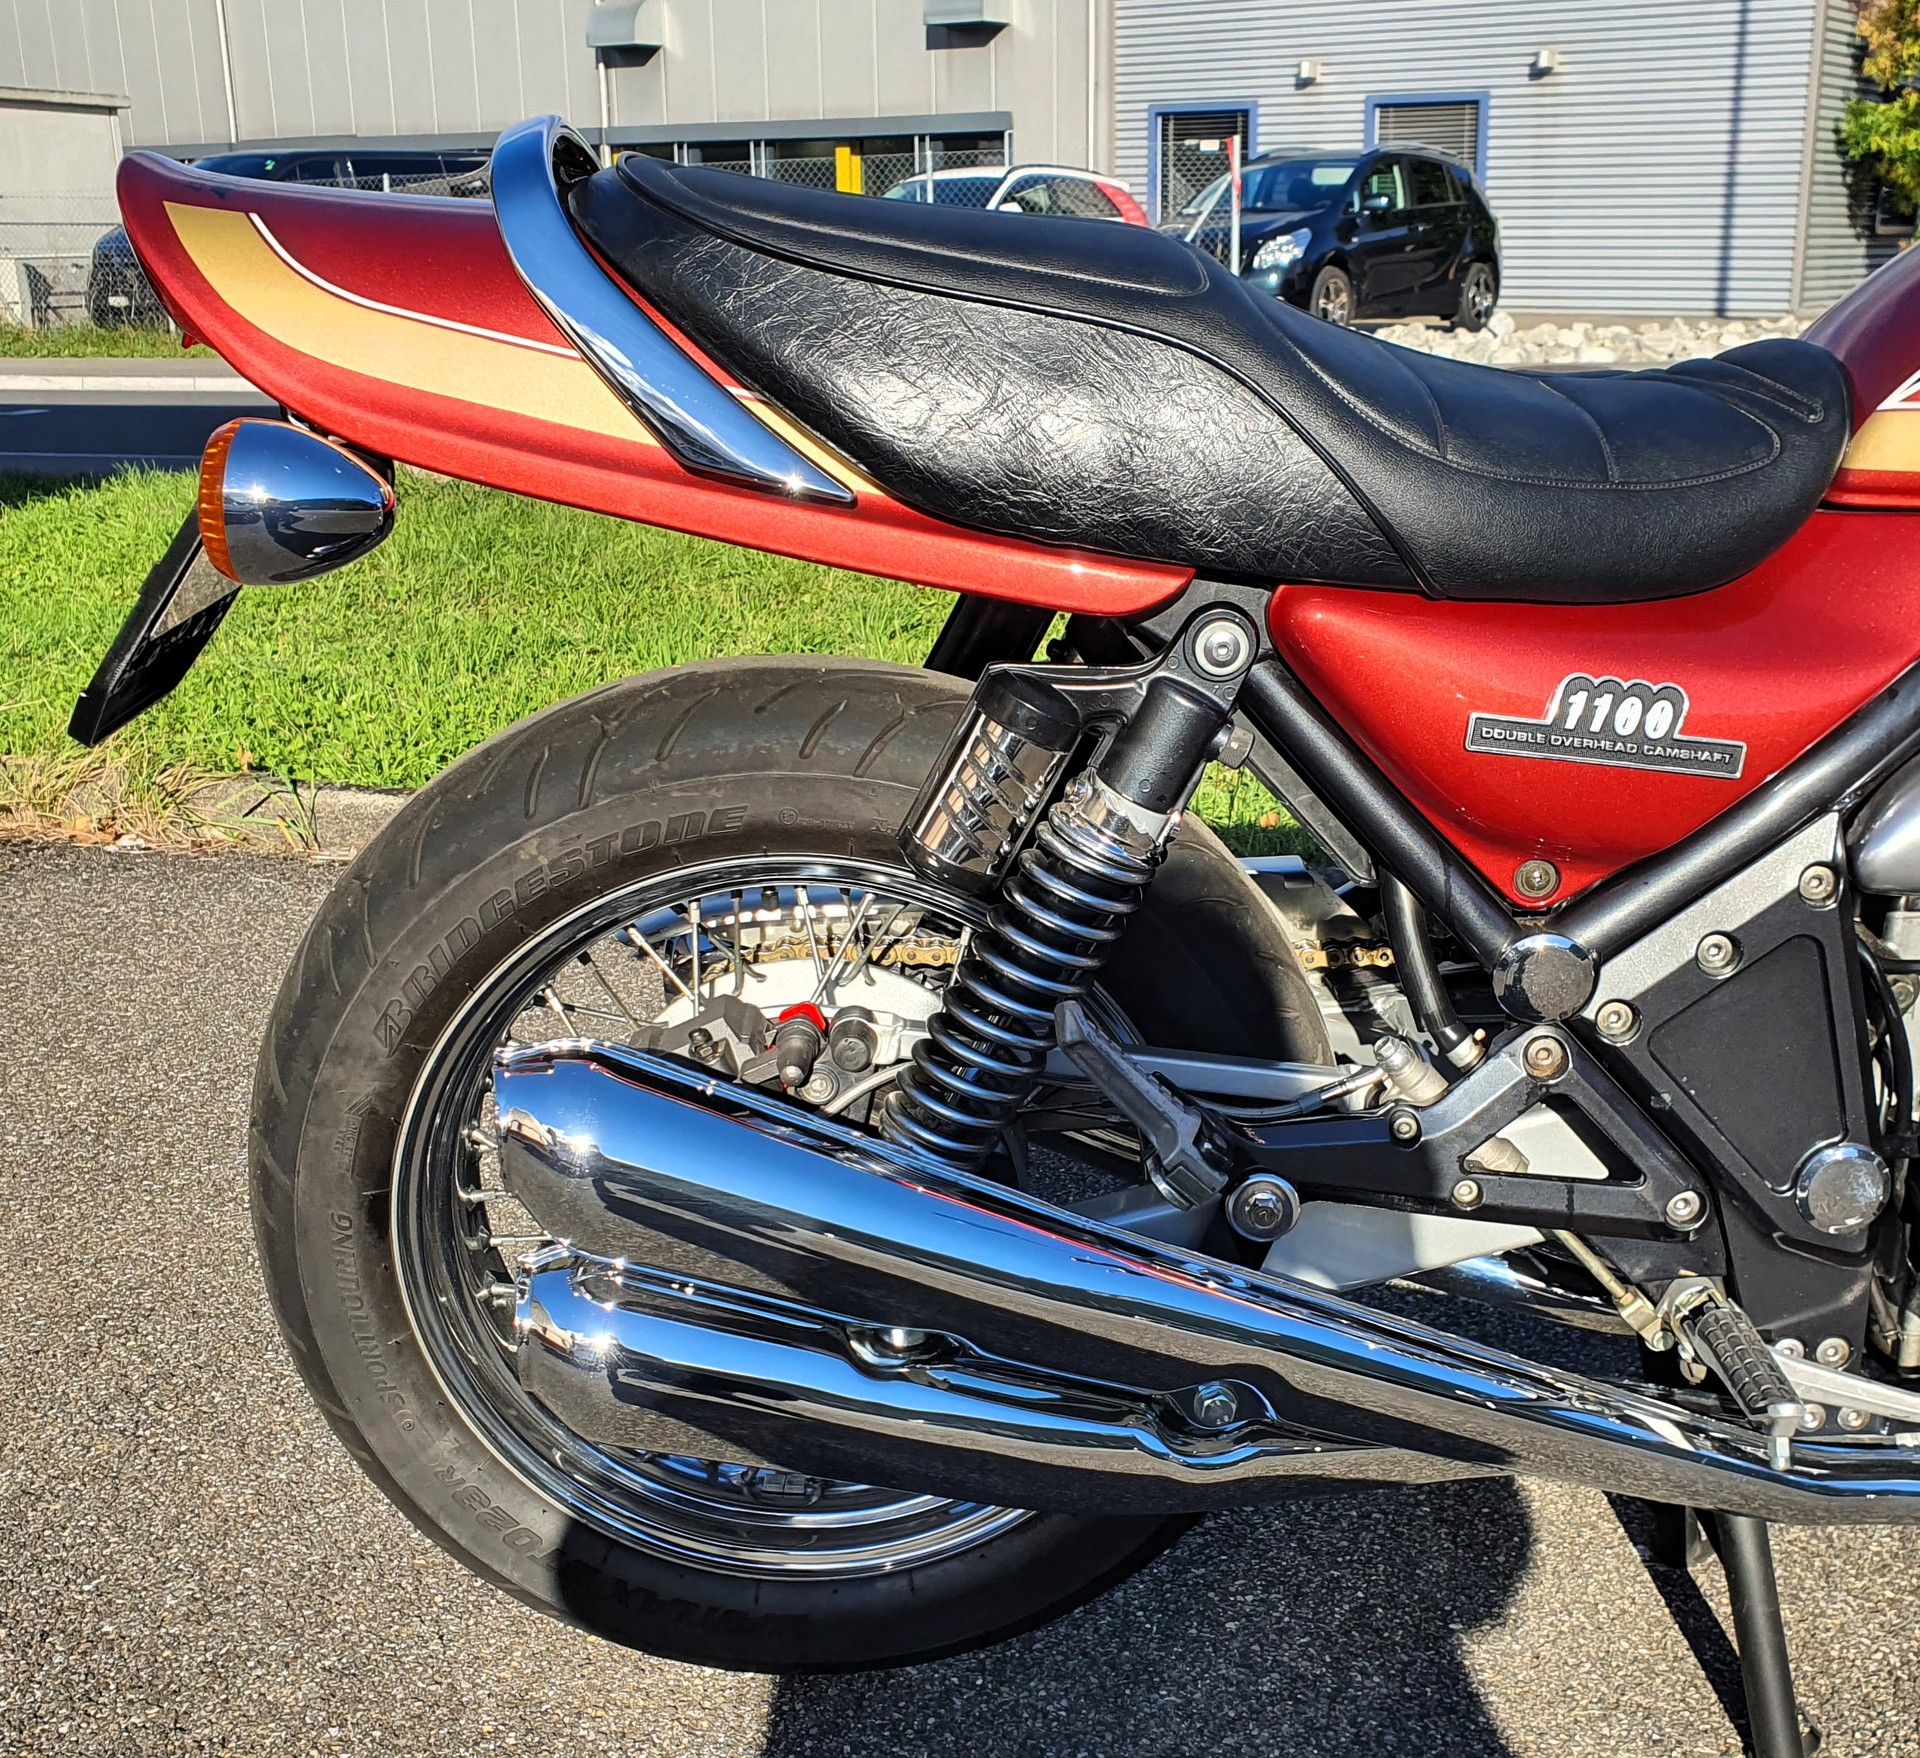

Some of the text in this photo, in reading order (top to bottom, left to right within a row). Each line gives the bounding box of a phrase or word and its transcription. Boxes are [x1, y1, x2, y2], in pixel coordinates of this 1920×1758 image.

[1480, 726, 1734, 766] DOUBLE OVERHEAD CAMSHAFT
[1563, 690, 1675, 740] 1100
[373, 803, 749, 1058] BRIDGESTONE
[329, 1210, 370, 1325] TOURING
[352, 1331, 406, 1408] SPORT
